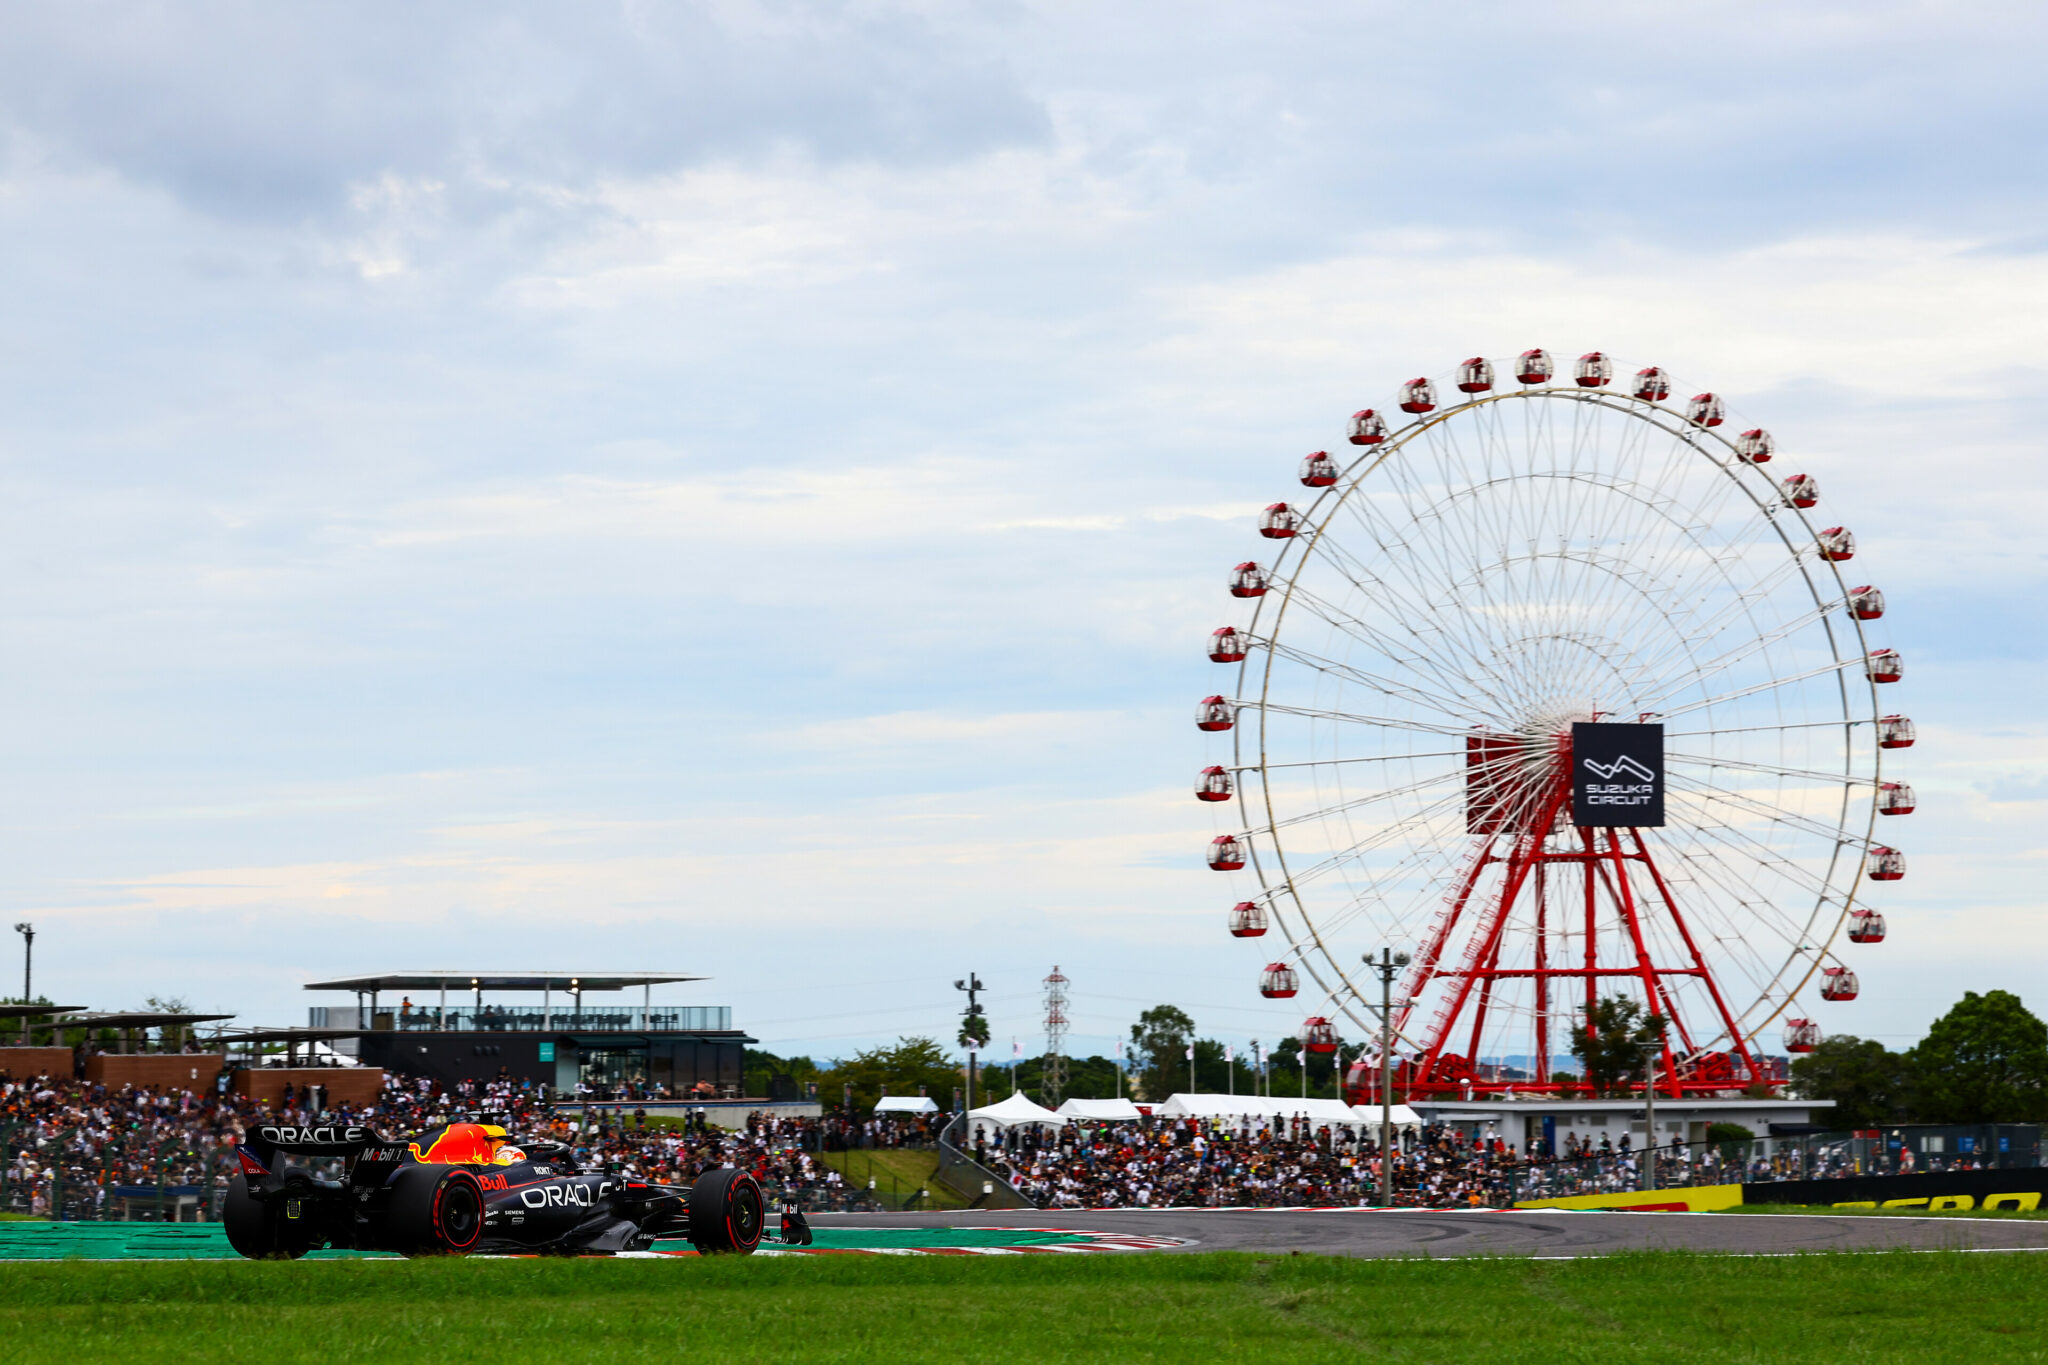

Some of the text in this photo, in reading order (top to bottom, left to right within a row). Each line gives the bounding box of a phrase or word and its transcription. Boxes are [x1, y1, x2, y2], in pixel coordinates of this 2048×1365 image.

[1586, 784, 1653, 793] SUZUKA
[1588, 796, 1651, 805] CIRCUIT
[261, 1127, 365, 1144] ORACLE
[361, 1148, 395, 1161] Mobil
[478, 1174, 509, 1190] Bull
[520, 1182, 612, 1208] ORACLE
[782, 1204, 798, 1214] Mobil
